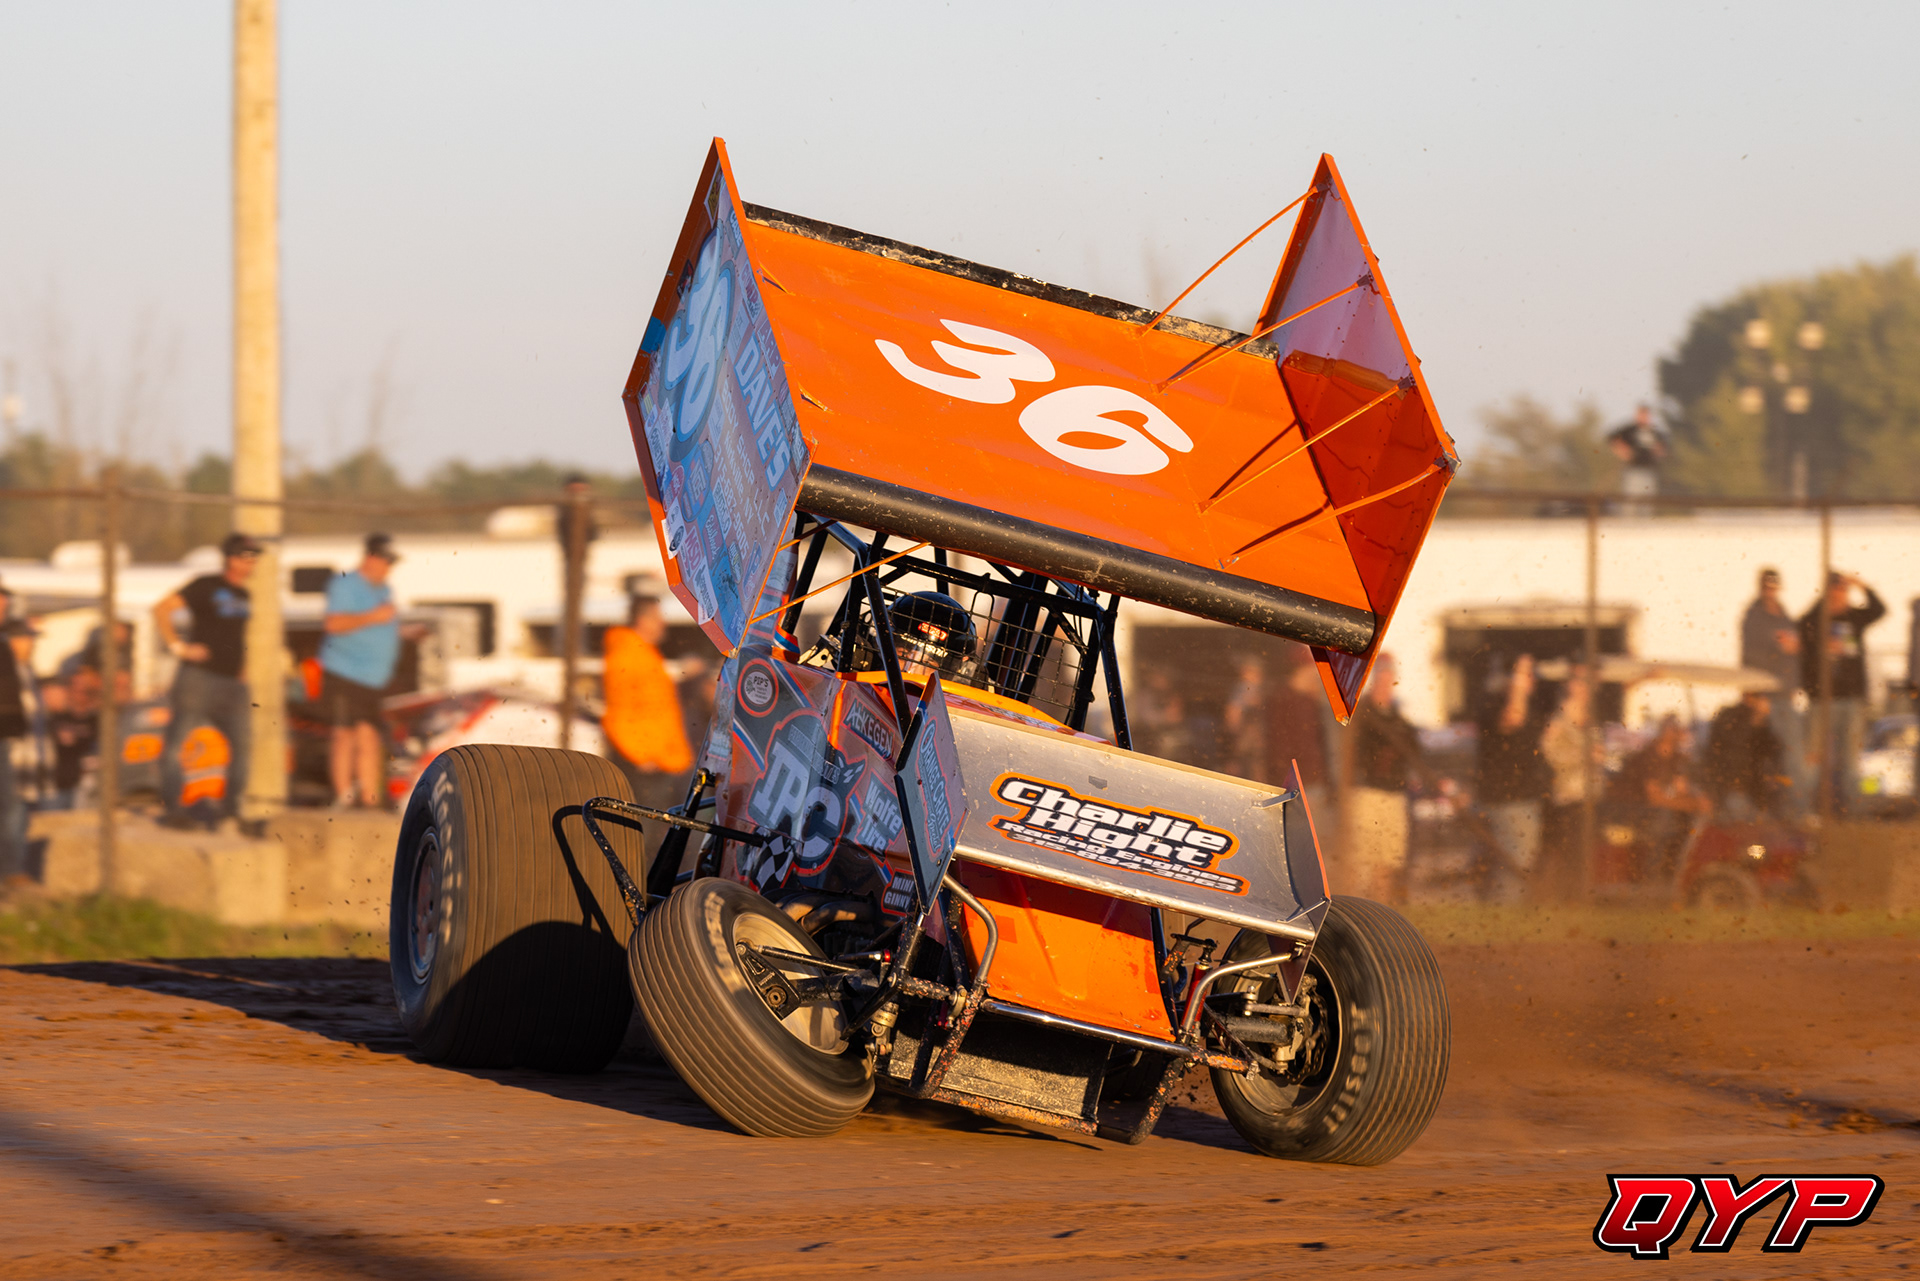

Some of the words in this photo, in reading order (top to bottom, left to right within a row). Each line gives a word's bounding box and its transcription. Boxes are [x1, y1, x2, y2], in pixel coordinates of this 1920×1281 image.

[665, 230, 729, 436] 36
[734, 334, 791, 490] DAVE'S
[874, 319, 1194, 475] 36
[722, 378, 739, 430] BODY
[736, 434, 755, 486] SHOP
[684, 527, 701, 571] MSD
[753, 675, 769, 688] PIP'S
[865, 780, 902, 836] Wolfe
[920, 723, 941, 790] ORANGE
[932, 780, 950, 834] CRATE
[860, 814, 887, 852] Tire
[1001, 780, 1228, 852] Charlie
[1026, 807, 1210, 867] Hight
[1001, 820, 1109, 855] Racing
[1113, 848, 1239, 885] Engines
[883, 891, 911, 909] GINNY
[891, 875, 915, 893] MINI
